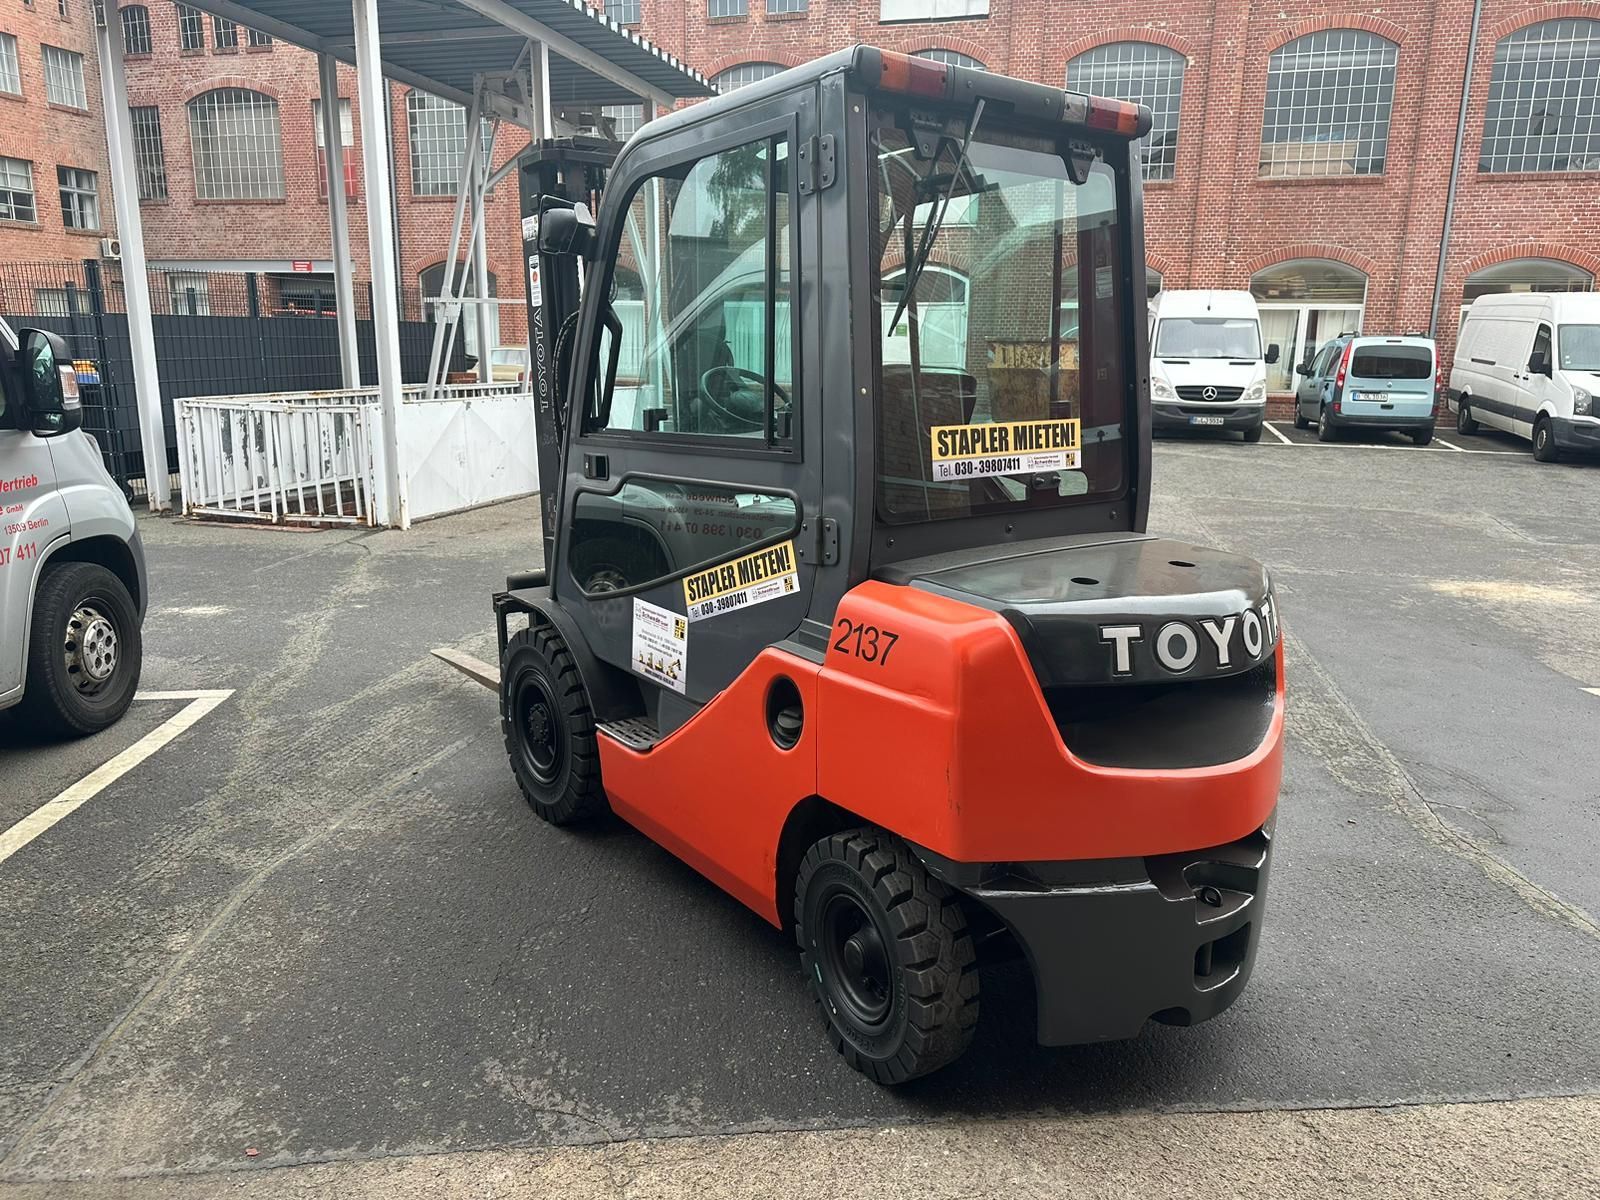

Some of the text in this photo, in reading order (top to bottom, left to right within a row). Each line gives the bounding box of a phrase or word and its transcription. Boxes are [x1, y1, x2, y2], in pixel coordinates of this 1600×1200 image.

[533, 307, 549, 414] TOYOTA
[937, 422, 1076, 457] STAPLER MIETEN!
[938, 464, 953, 477] Tel.
[6, 504, 23, 515] GmbH
[4, 518, 49, 535] 13509 Berlin
[17, 541, 37, 560] 411
[687, 545, 791, 602] STAPLER MIETEN!
[833, 617, 899, 666] 2137
